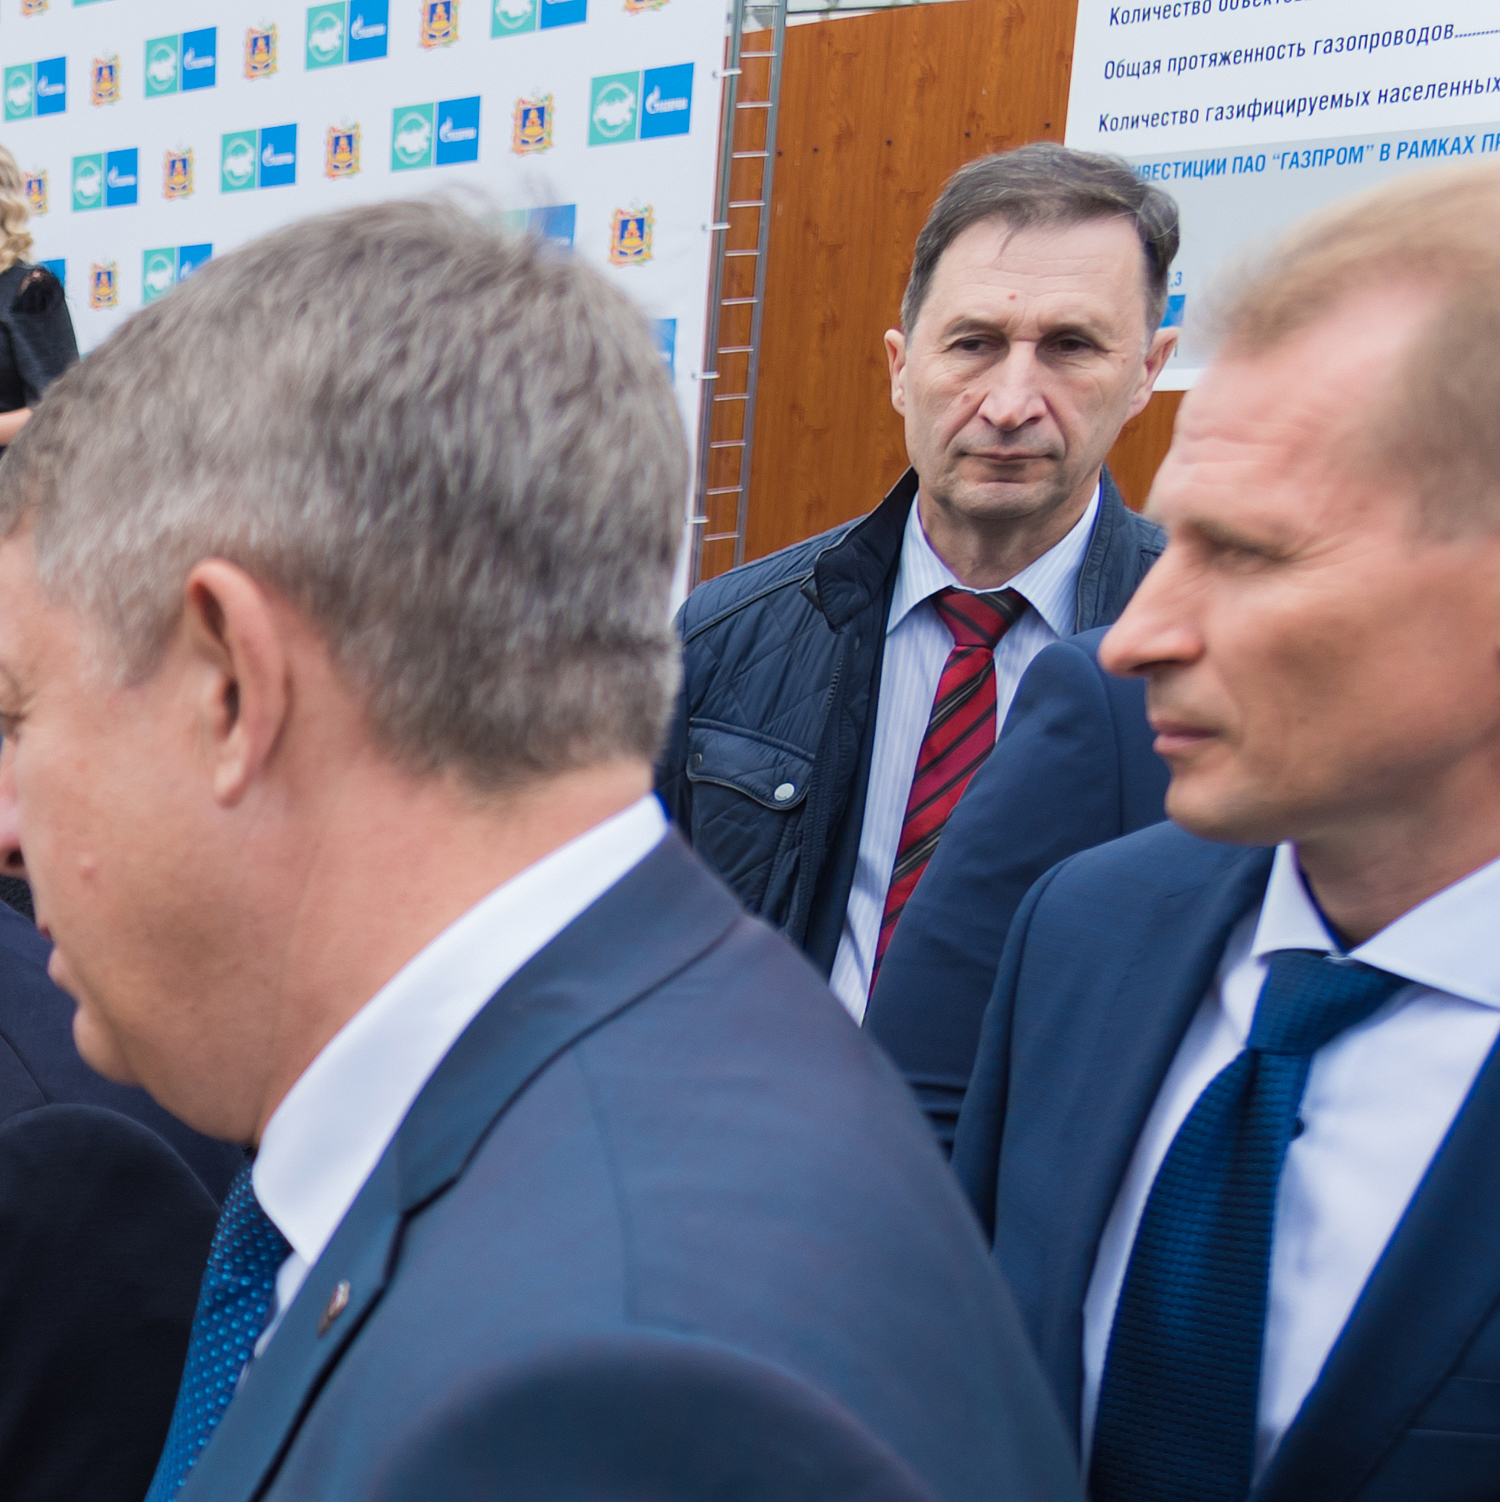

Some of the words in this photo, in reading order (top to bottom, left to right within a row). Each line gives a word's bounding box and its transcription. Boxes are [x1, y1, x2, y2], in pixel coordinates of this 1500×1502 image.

[1109, 0, 1212, 26] Количество
[1103, 58, 1162, 80] Общая
[1167, 42, 1306, 76] протяженность
[1098, 108, 1200, 133] Количество
[1205, 89, 1372, 122] газифицируемых
[1231, 154, 1267, 175] ПАО
[1379, 143, 1391, 162] В
[1396, 135, 1476, 160] РАМКАХ
